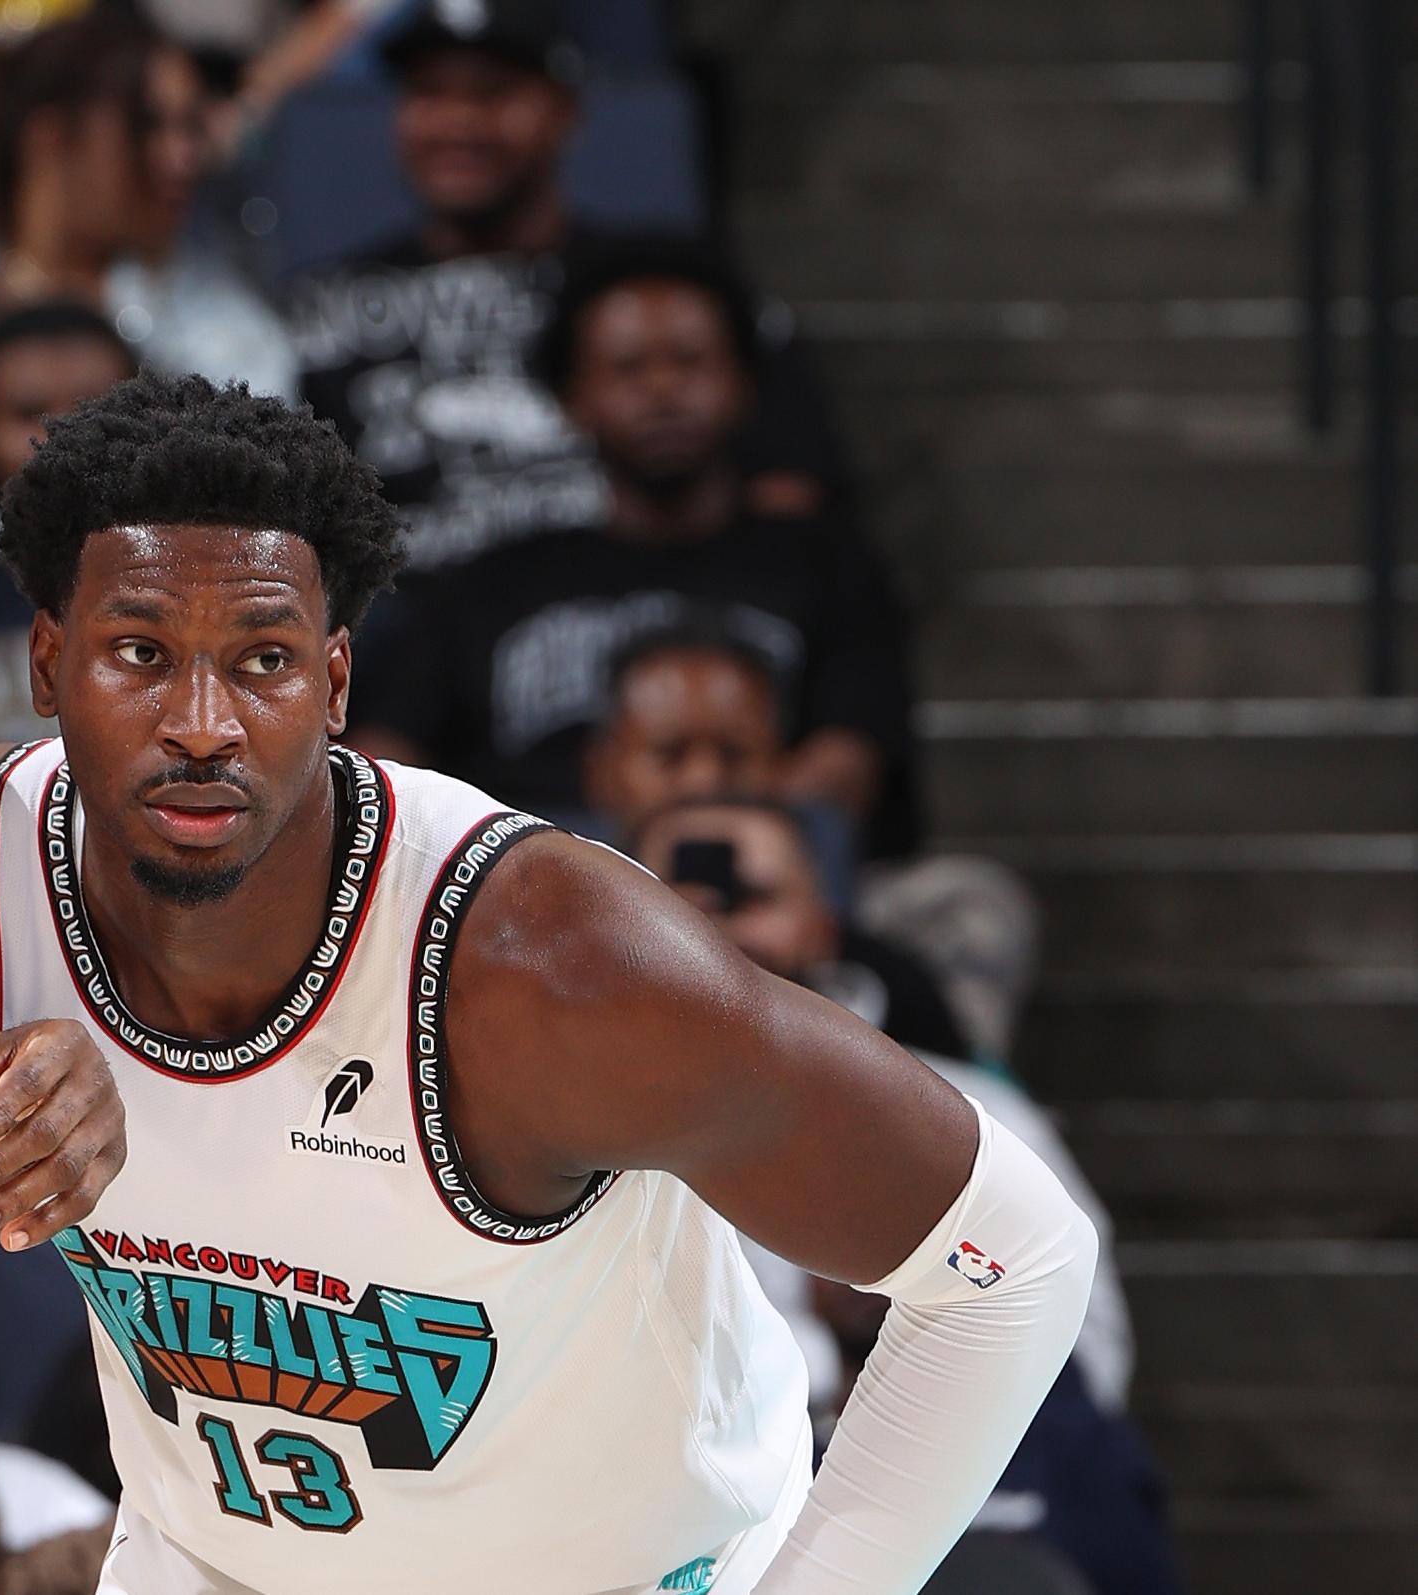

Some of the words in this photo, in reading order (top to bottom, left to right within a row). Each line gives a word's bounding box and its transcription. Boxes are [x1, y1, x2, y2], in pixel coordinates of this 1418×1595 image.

[290, 1130, 406, 1164] Robinhood
[90, 1229, 355, 1305] VANCOUVER
[195, 1411, 364, 1534] 13
